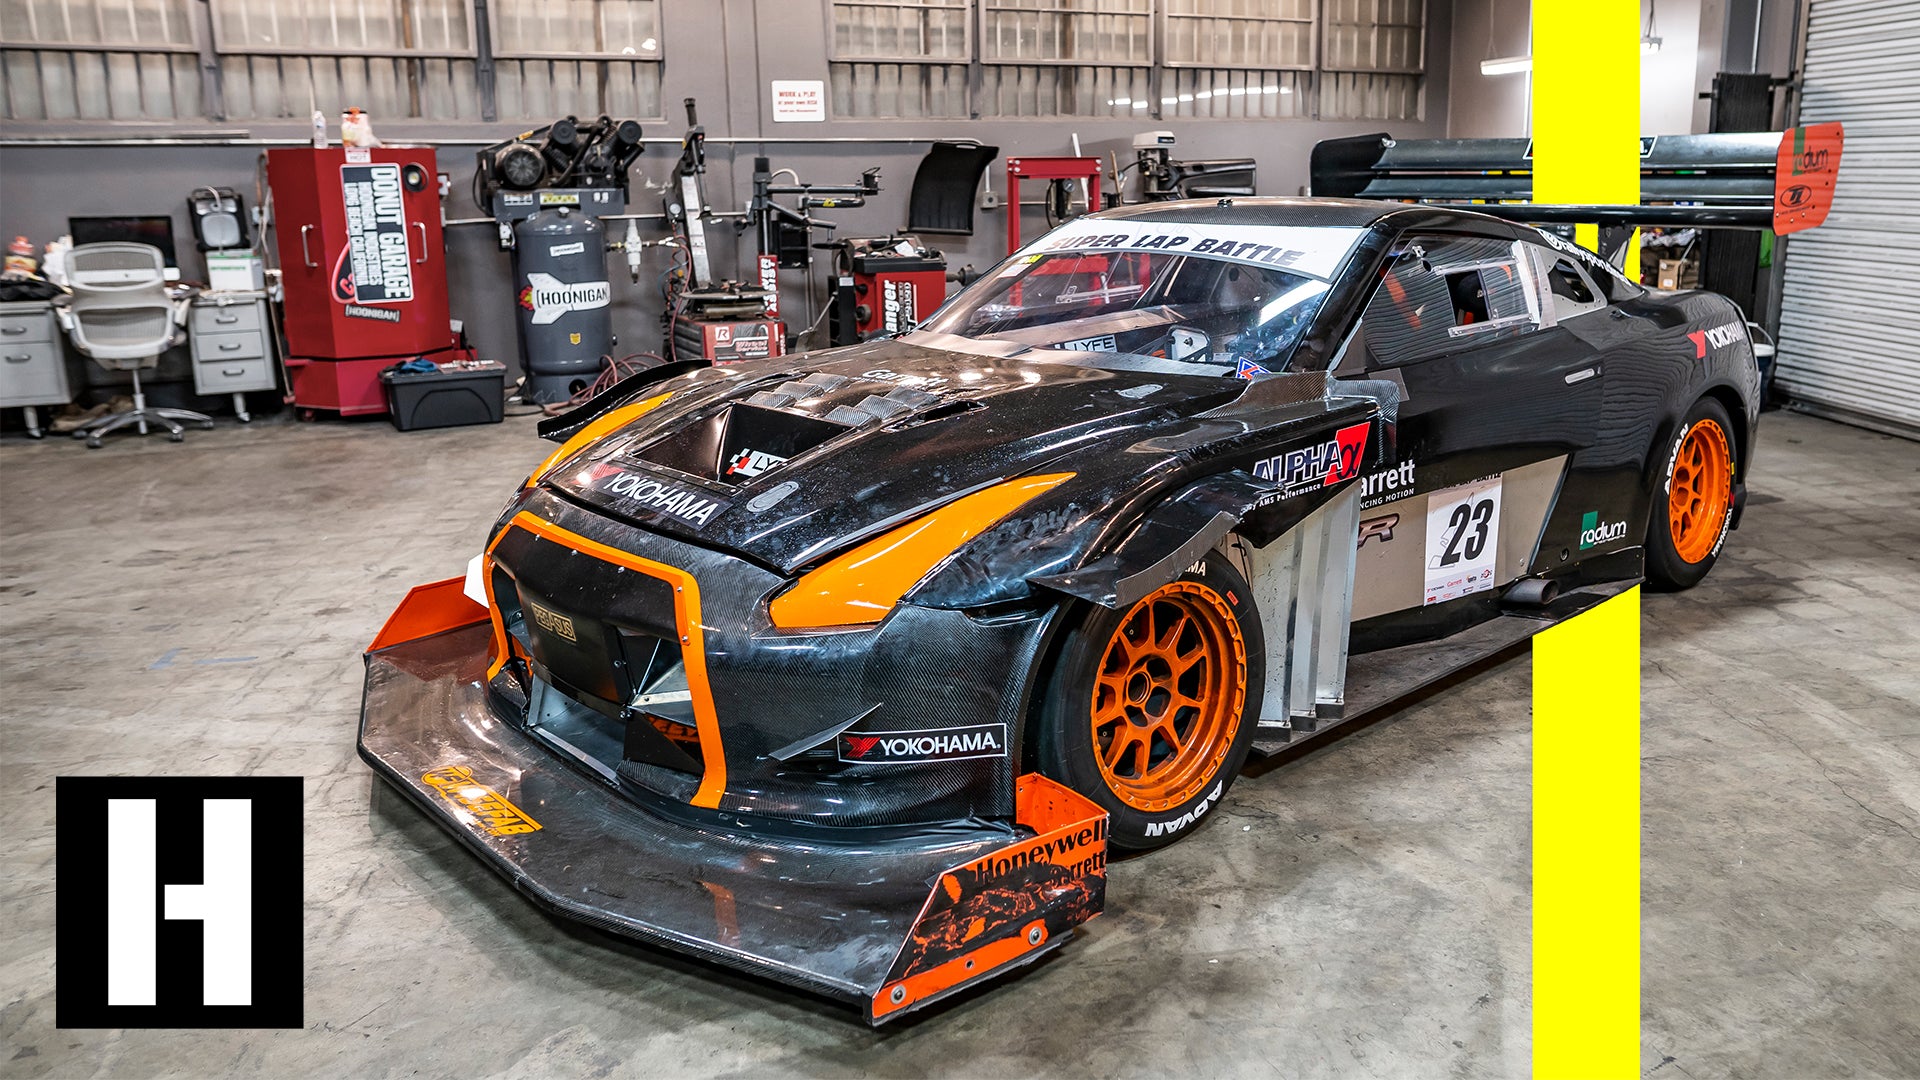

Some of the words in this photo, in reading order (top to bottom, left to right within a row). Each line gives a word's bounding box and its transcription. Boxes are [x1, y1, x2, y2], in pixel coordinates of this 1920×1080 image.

[371, 168, 402, 226] DONUT
[378, 232, 411, 298] GARAGE
[1045, 234, 1129, 251] SUPER
[1131, 234, 1189, 249] LAP
[1191, 239, 1303, 266] BATTLE
[1252, 440, 1343, 486] ALPHA
[1361, 459, 1416, 498] arrett
[1664, 423, 1689, 496] ADVAN
[603, 472, 719, 525] YOKOHAMA
[1386, 487, 1414, 502] MOTION
[1440, 498, 1494, 566] 23
[1144, 779, 1223, 837] ADVAN
[976, 819, 1107, 884] Honeywell
